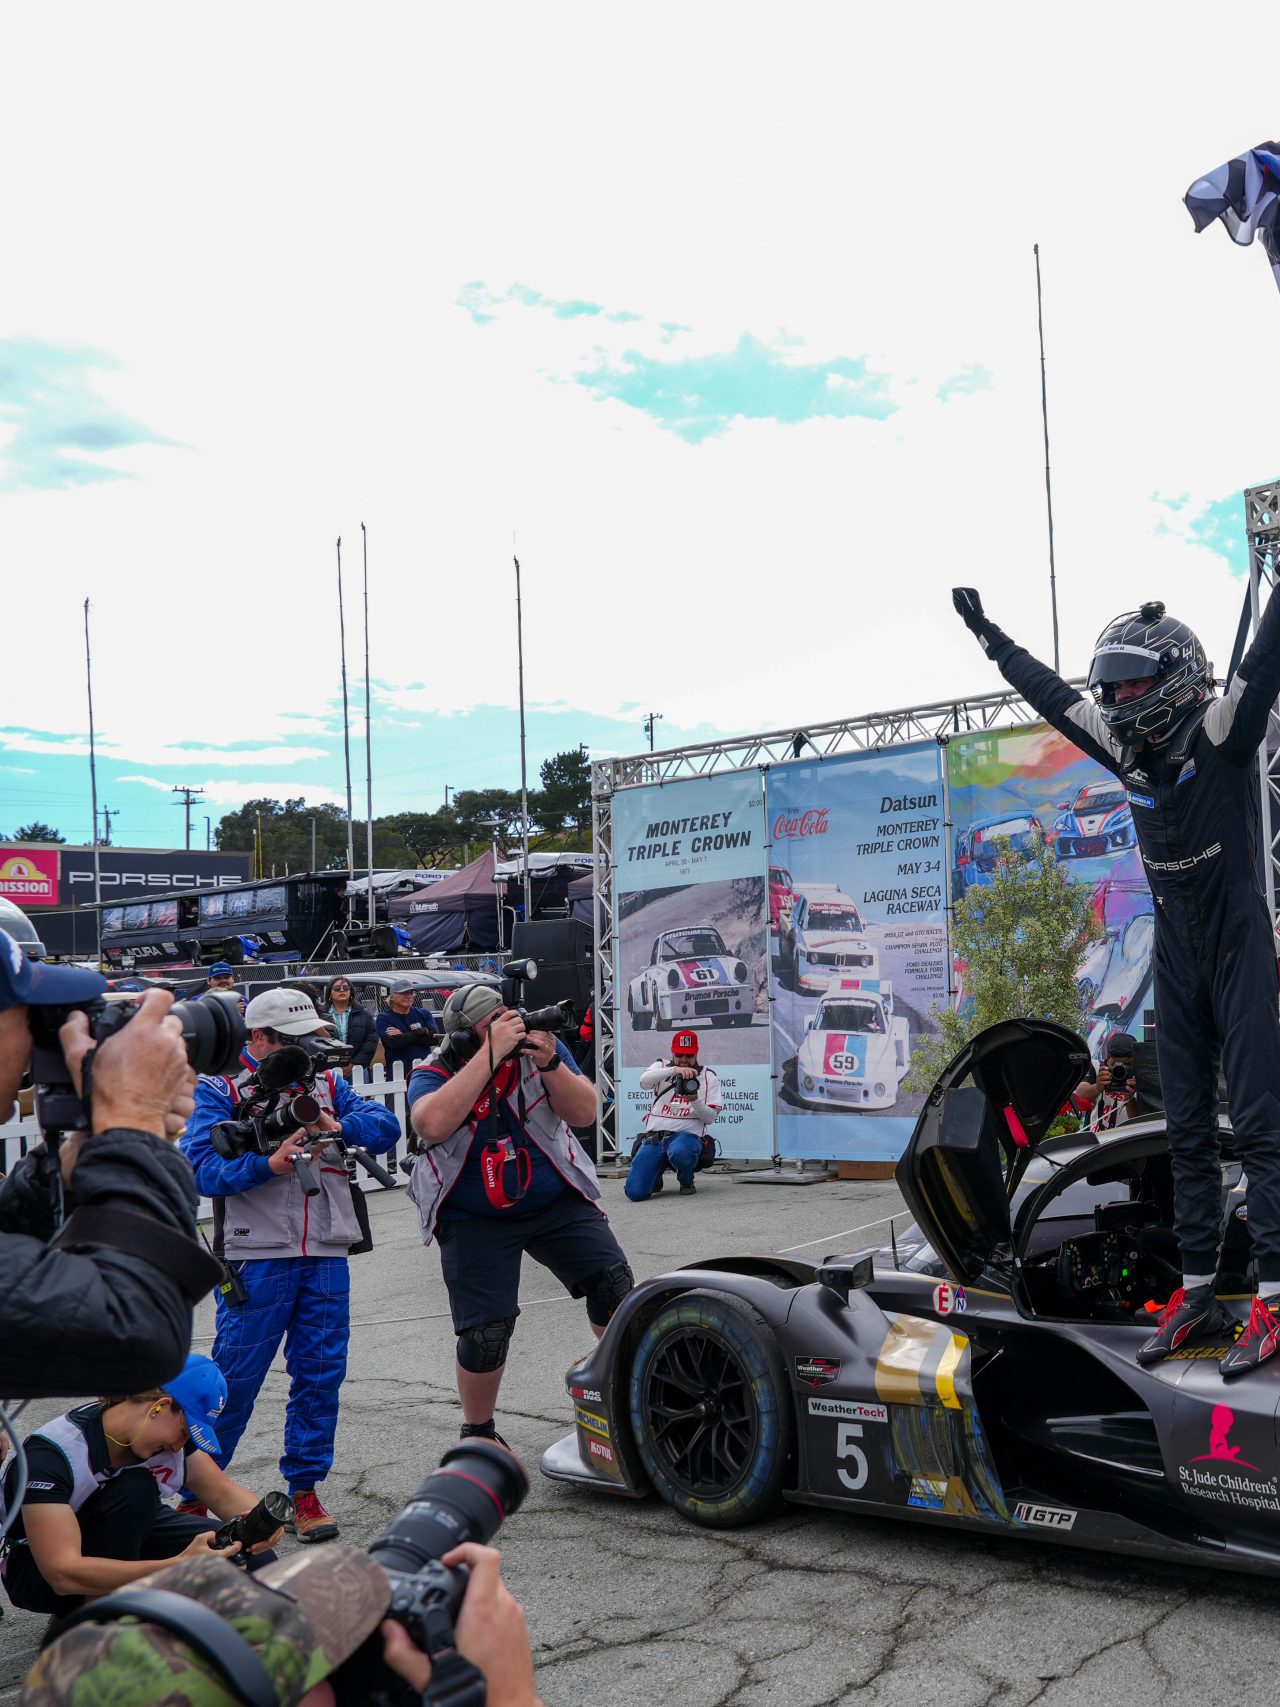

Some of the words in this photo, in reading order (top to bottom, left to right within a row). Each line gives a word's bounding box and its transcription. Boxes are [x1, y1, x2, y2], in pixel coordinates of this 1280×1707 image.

[880, 794, 938, 813] Datsun
[646, 811, 732, 838] MONTEREY
[876, 819, 939, 837] MONTEREY
[628, 840, 682, 861] TRIPLE
[691, 830, 751, 853] CROWN
[856, 841, 893, 856] TRIPLE
[897, 836, 940, 850] CROWN
[897, 861, 922, 875] MAY
[924, 860, 941, 872] 3-4
[69, 871, 242, 887] PORSCHE
[863, 888, 908, 903] LAGUNA
[911, 885, 941, 899] SECA
[887, 899, 941, 915] RACEWAY
[126, 945, 162, 959] ACURA
[833, 1055, 855, 1070] 59
[728, 1115, 743, 1123] CUP
[486, 1157, 496, 1188] Canon
[591, 1441, 612, 1460] MOTUL
[837, 1422, 868, 1491] 5
[1179, 1466, 1192, 1481] St.
[1193, 1468, 1217, 1486] Jude
[1218, 1474, 1277, 1495] Children's
[1181, 1482, 1230, 1503] Research
[1032, 1510, 1072, 1524] GTP
